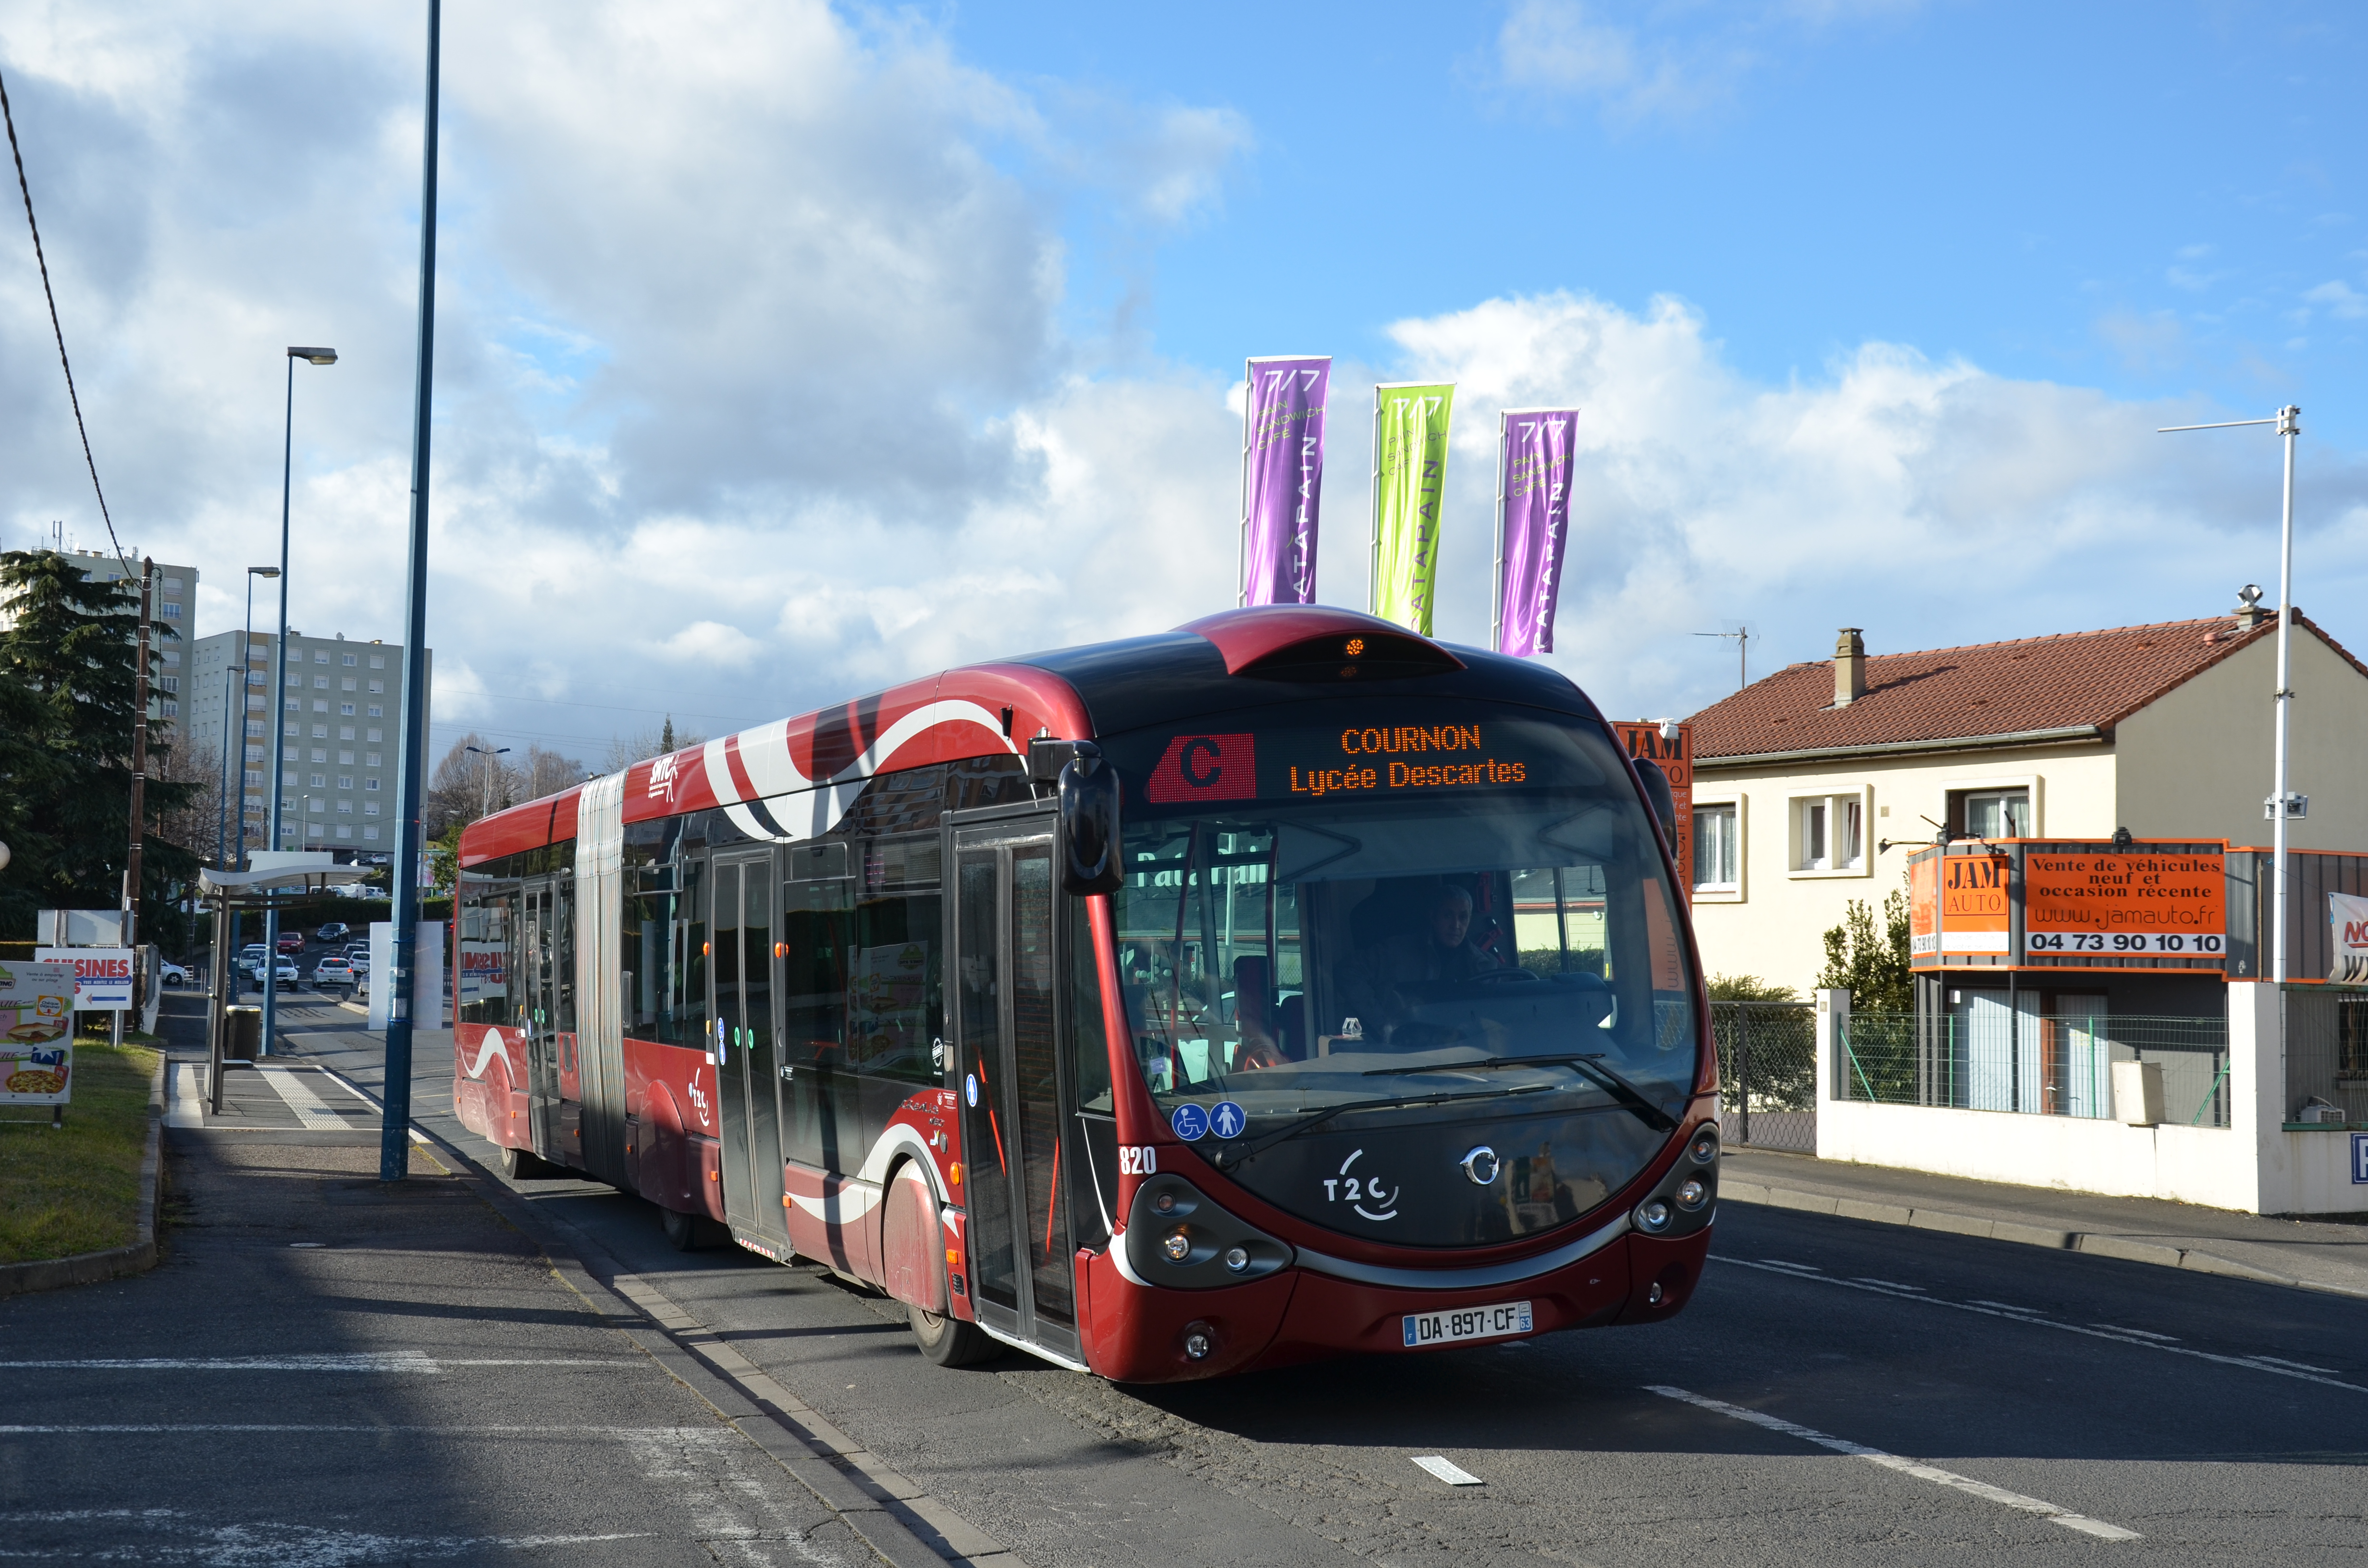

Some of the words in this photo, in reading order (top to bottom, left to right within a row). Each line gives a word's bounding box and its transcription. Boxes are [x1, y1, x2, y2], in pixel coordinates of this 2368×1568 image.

[1265, 369, 1320, 392] 7/7
[1258, 400, 1288, 419] PAIN
[1393, 396, 1443, 419] 7/7
[1257, 405, 1325, 436] SANDWICH
[1518, 420, 1567, 443] 7/7
[1388, 428, 1414, 446] PAIN
[1513, 453, 1571, 483] SANDWICH
[1514, 452, 1542, 468] PAIN
[1533, 482, 1565, 650] PATAPAIN
[1342, 725, 1480, 753] COURNON
[1180, 737, 1222, 788] C
[1290, 764, 1377, 796] Lycée
[1389, 759, 1526, 787] Descartes
[1948, 861, 2002, 890] JAM
[2033, 858, 2085, 871] Vente
[2094, 859, 2116, 871] de
[2127, 859, 2220, 872] véhicules
[2089, 871, 2134, 884] neuf
[2144, 872, 2161, 884] et
[2039, 884, 2128, 897] occasion
[2137, 884, 2212, 898] récente
[1949, 894, 2001, 912] AUTO
[2035, 905, 2216, 930] www.jamauto.fr
[2031, 933, 2068, 950] 04
[2072, 934, 2109, 951] 73
[2113, 934, 2152, 951] 90
[2156, 934, 2189, 951] 10
[2193, 935, 2226, 952] 10
[1120, 1147, 1156, 1175] 820
[1324, 1176, 1385, 1201] T2C
[1419, 1307, 1515, 1340] DA-897-CF
[1519, 1317, 1530, 1329] 63
